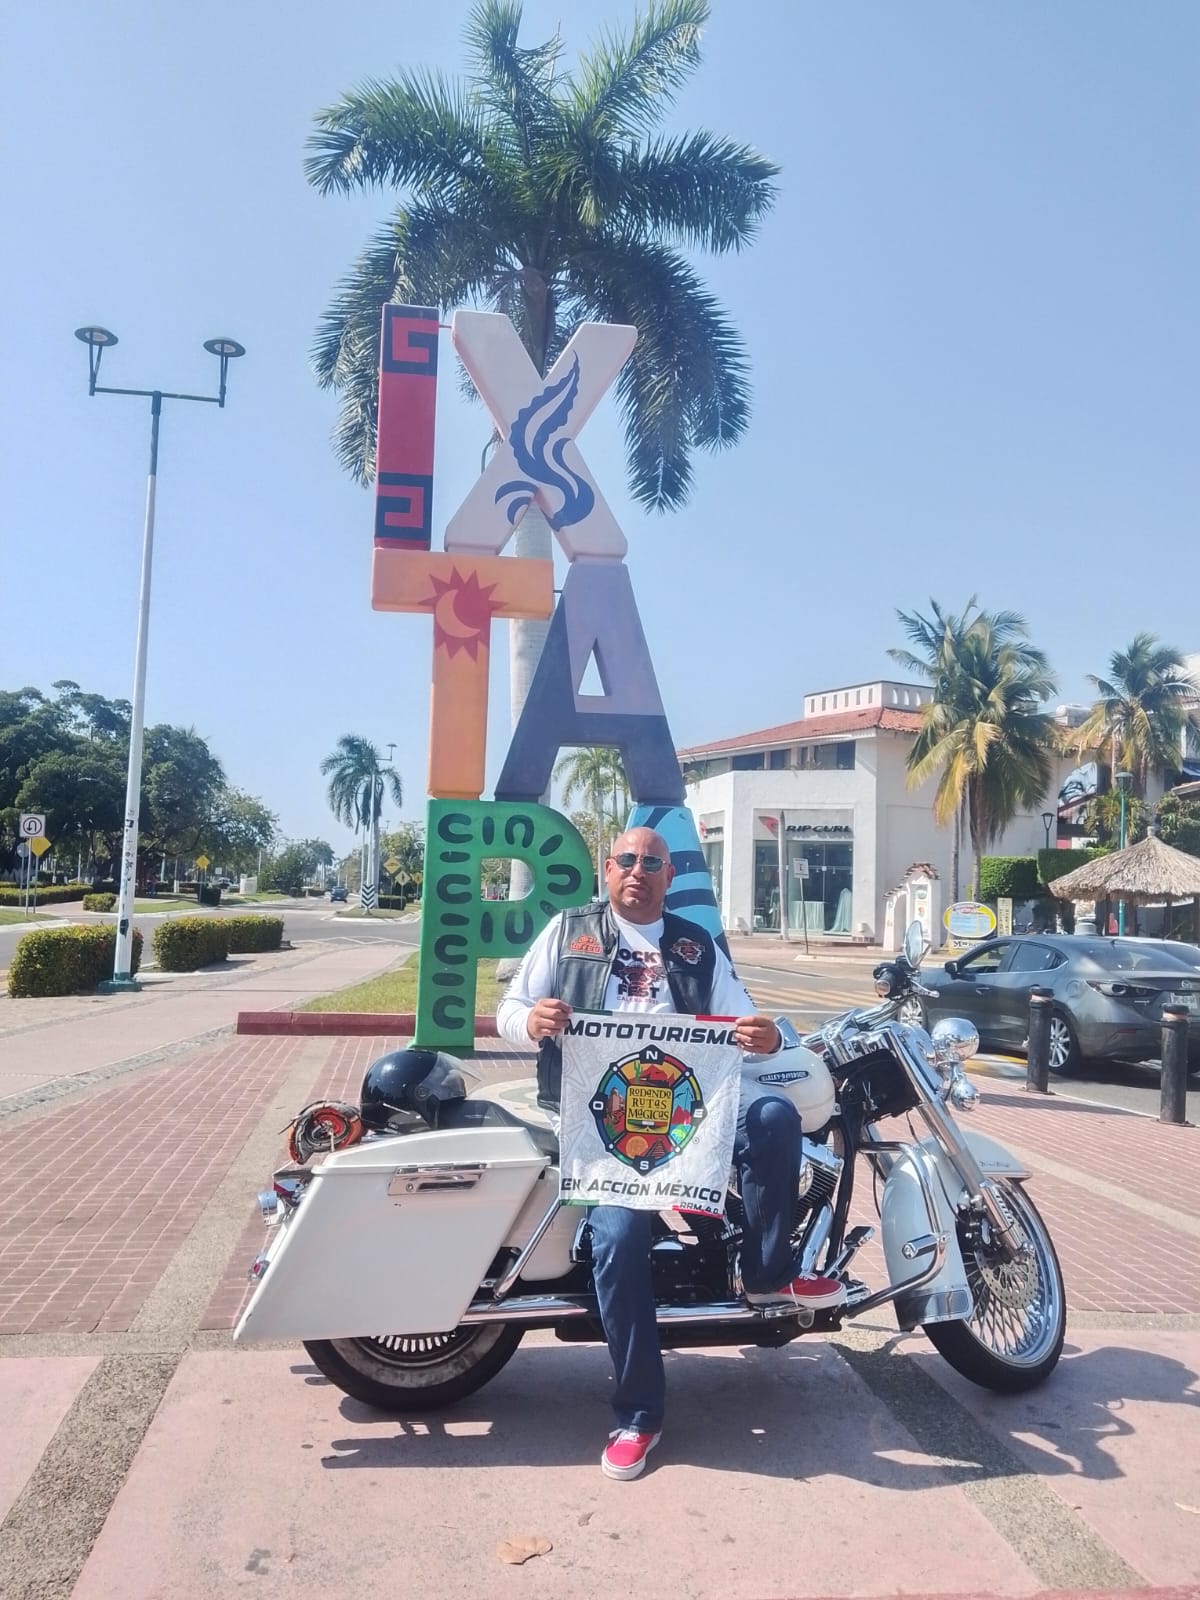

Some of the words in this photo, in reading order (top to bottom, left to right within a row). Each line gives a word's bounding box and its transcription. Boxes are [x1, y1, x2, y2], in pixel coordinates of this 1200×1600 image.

[614, 948, 661, 964] OCK
[617, 983, 660, 998] FEST
[564, 1018, 739, 1047] MOTOTURISMO
[645, 1050, 658, 1060] N
[693, 1108, 704, 1118] E
[639, 1160, 650, 1170] S
[560, 1177, 581, 1191] EN
